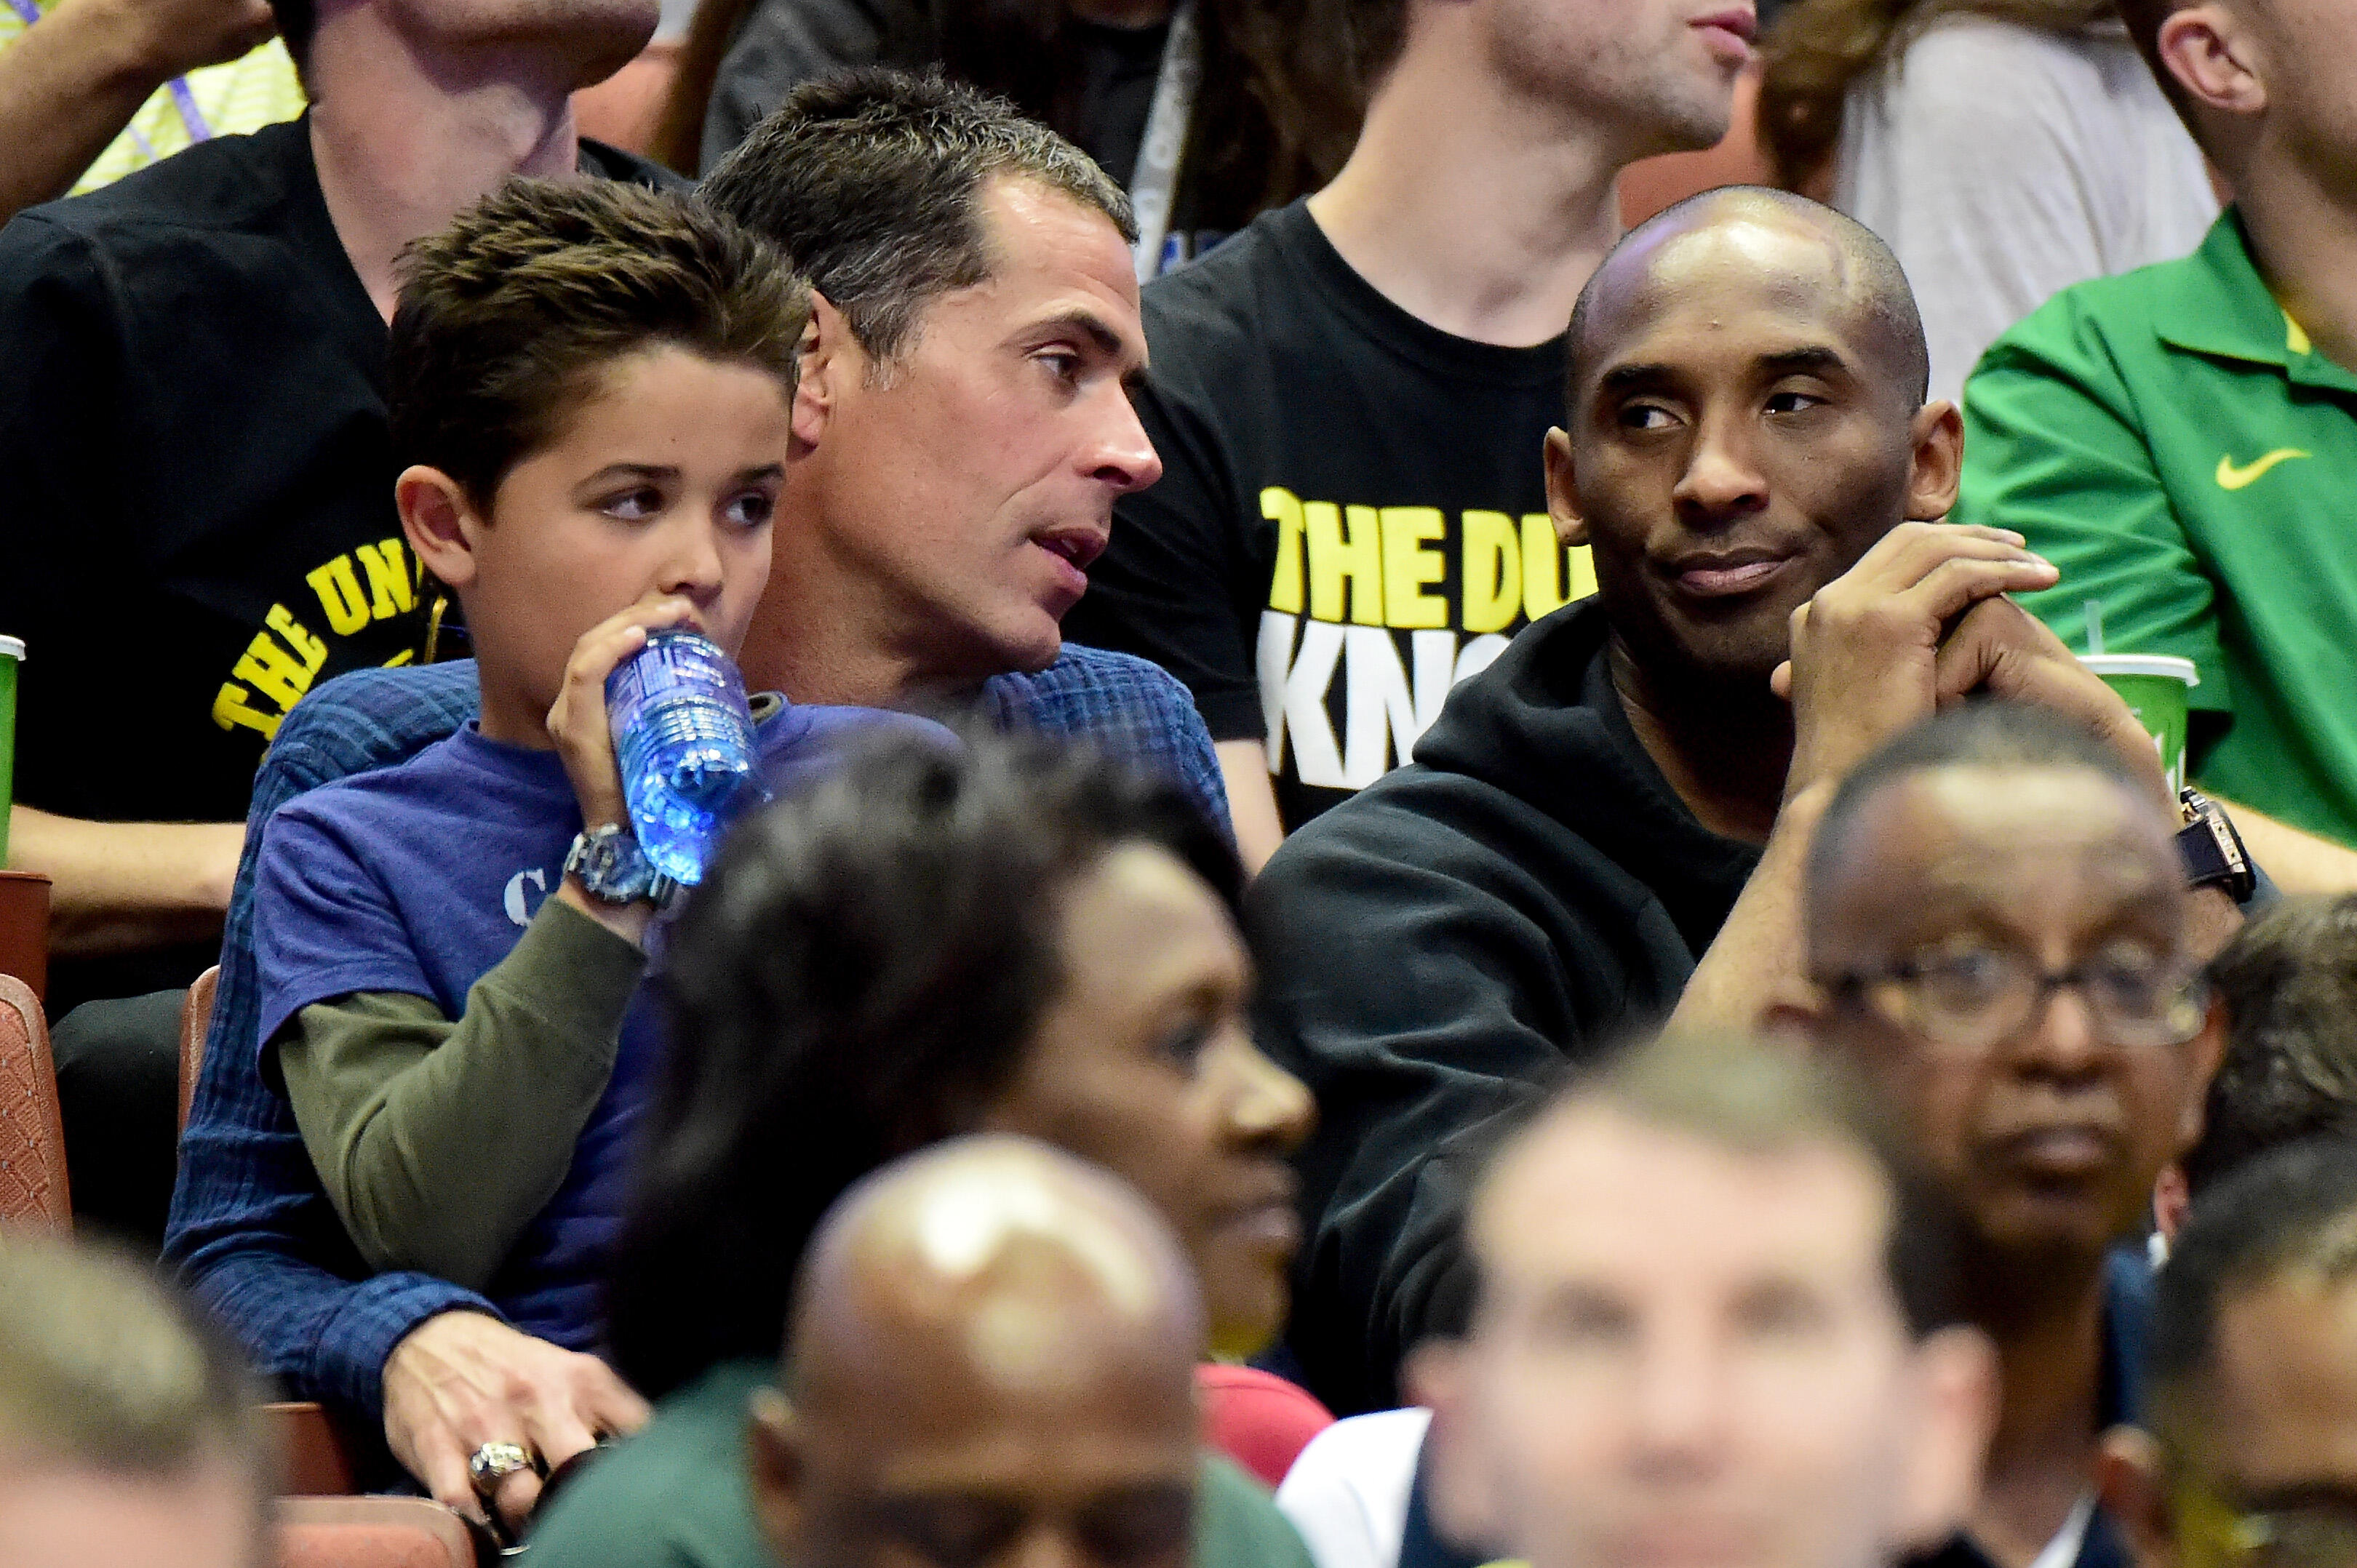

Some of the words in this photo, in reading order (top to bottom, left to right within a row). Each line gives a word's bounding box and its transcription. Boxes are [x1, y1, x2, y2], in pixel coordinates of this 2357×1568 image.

[211, 602, 329, 743] THE
[306, 537, 424, 636] UN
[1259, 487, 1449, 630] THE
